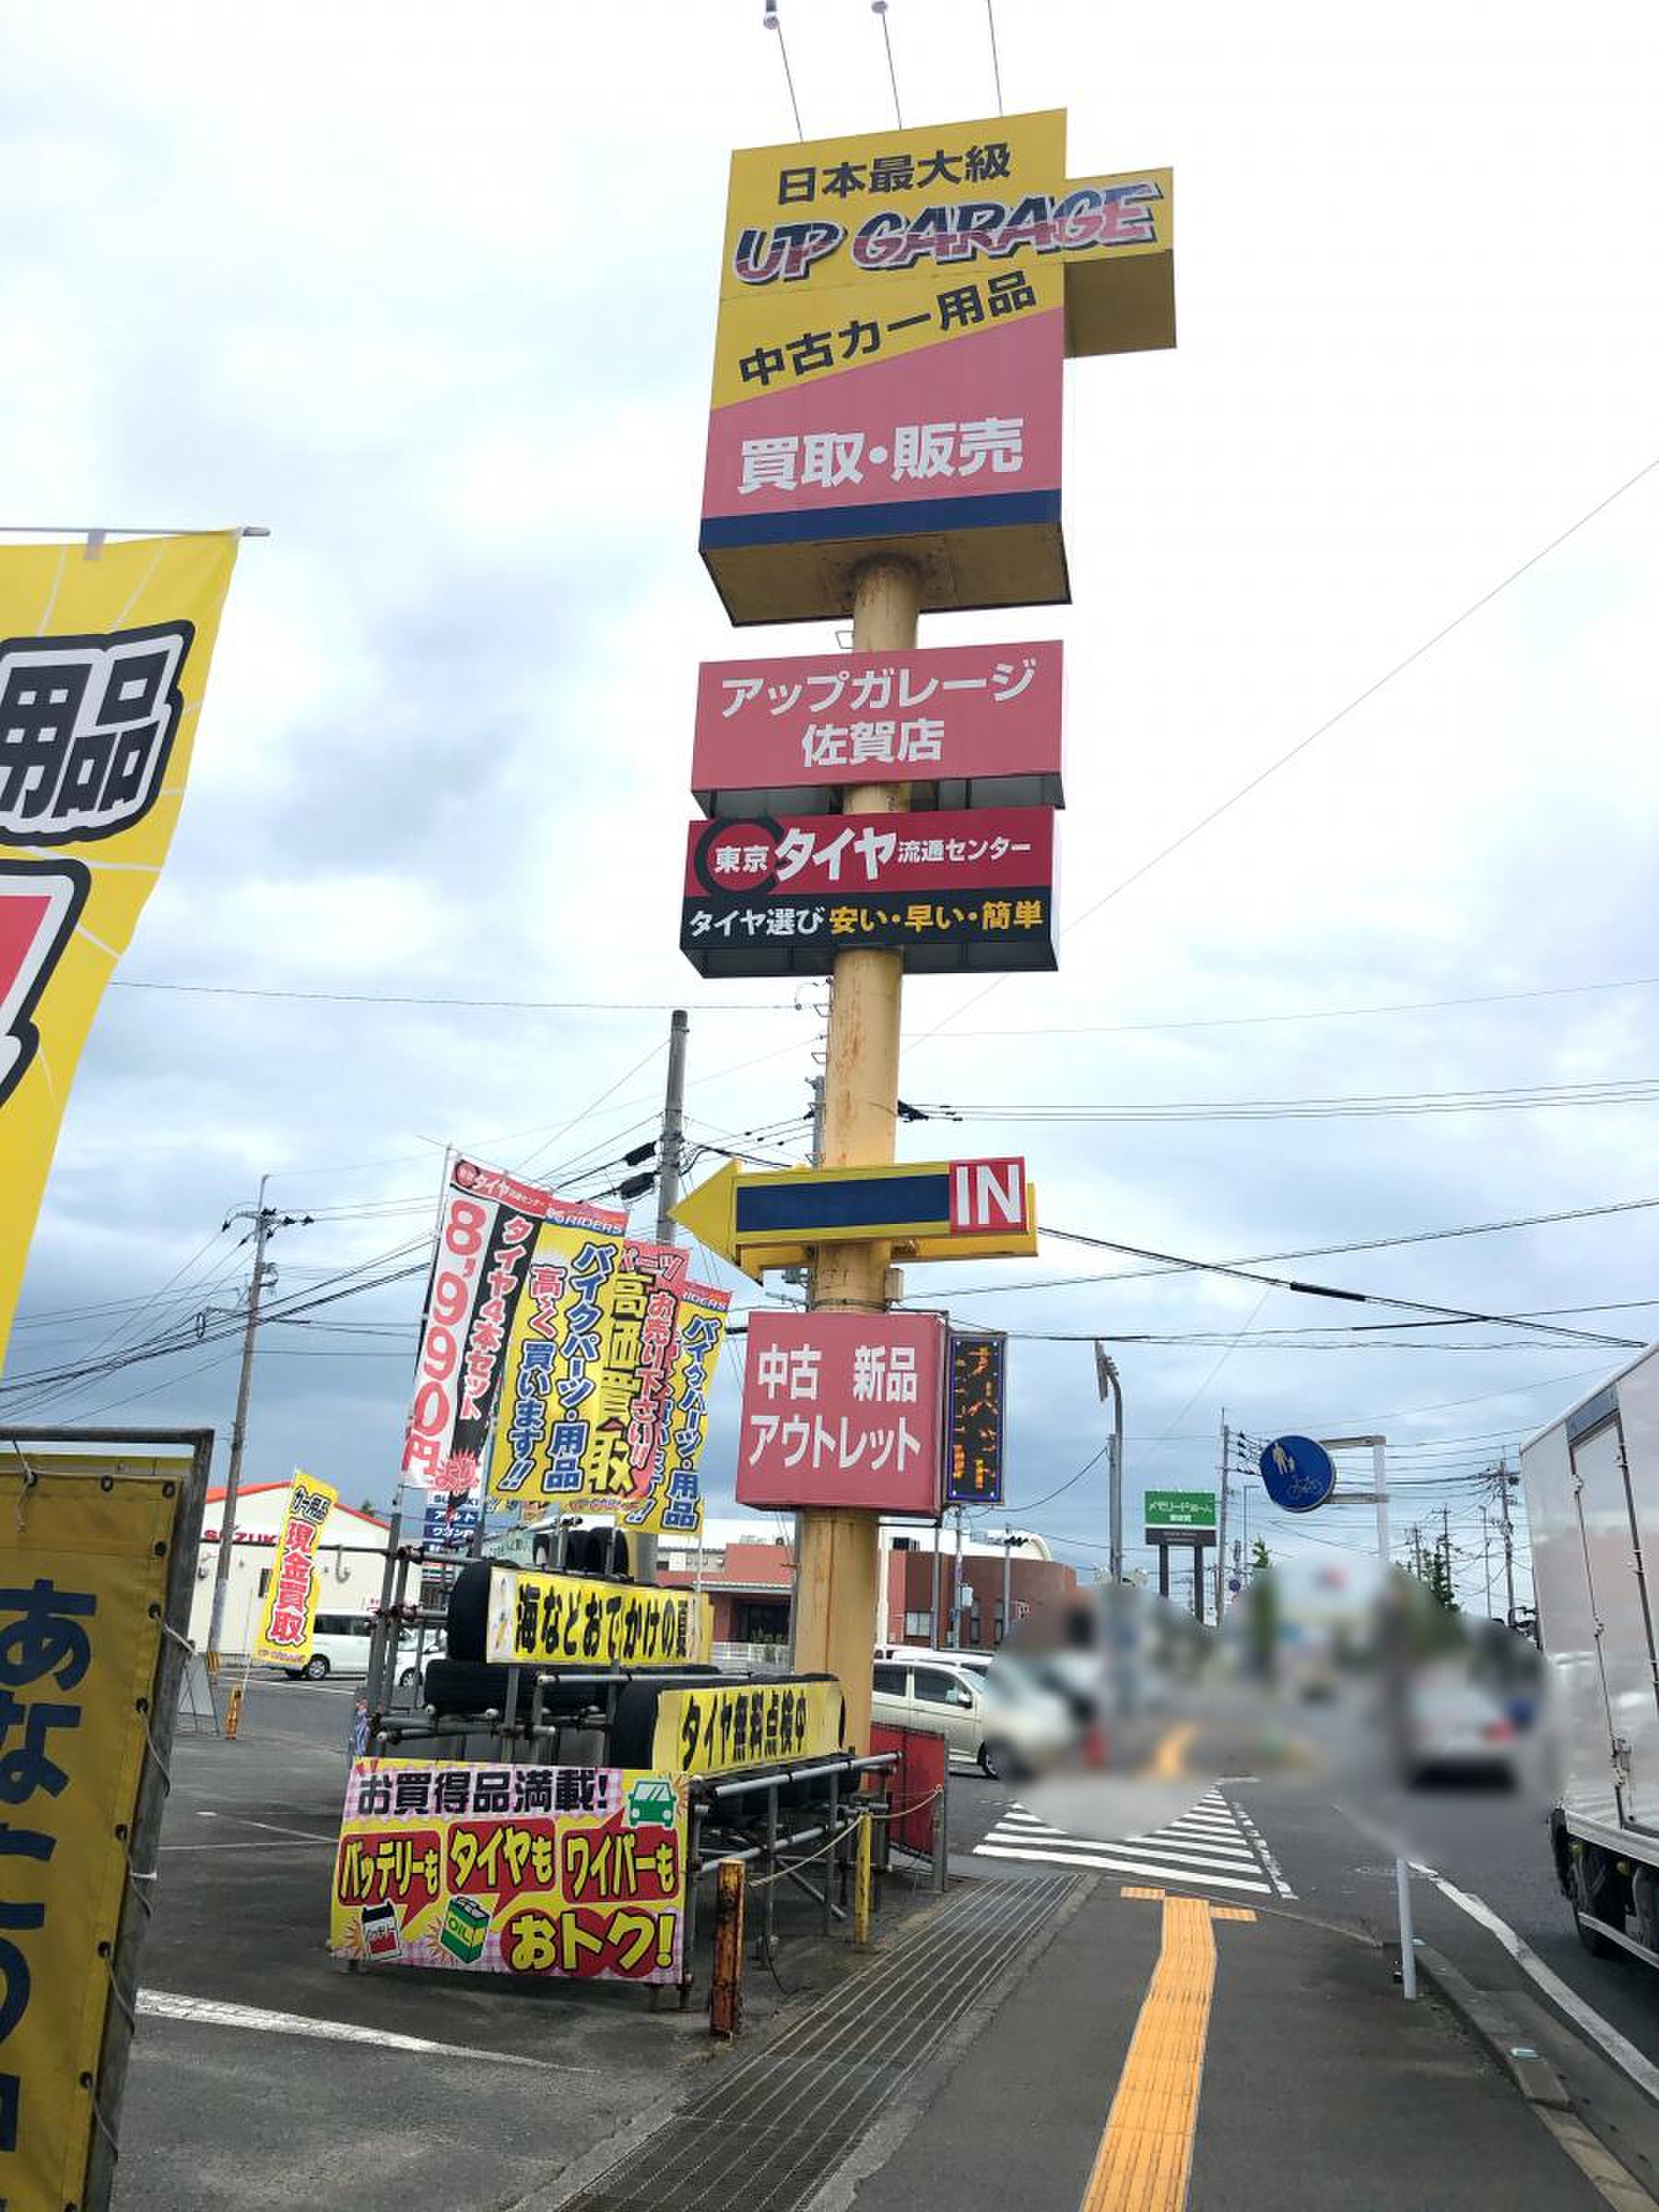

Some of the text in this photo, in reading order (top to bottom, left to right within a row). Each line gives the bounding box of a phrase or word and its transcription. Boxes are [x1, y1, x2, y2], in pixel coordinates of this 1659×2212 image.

[778, 141, 1011, 205] 日本最大級
[734, 182, 1164, 287] UP GARAGE
[739, 270, 1037, 386] 中古カー用品
[737, 418, 1024, 494] 買取・販売
[722, 657, 1036, 718] アップガレージ
[802, 719, 944, 768] 佐賀店
[955, 1164, 1023, 1225] IN
[460, 1216, 533, 1420] タイヤ4本セット
[544, 1243, 617, 1492] バイクパーツ・用品
[758, 1343, 917, 1402] 中古 新品
[748, 1415, 920, 1470] アウトレット
[270, 1522, 314, 1643] 現金買取
[358, 1771, 608, 1817] お買得品満載!
[339, 1841, 440, 1900] バッテリーも
[449, 1822, 556, 1888] タイヤも
[448, 1916, 473, 1947] OIL
[510, 1911, 673, 1973] おトク!
